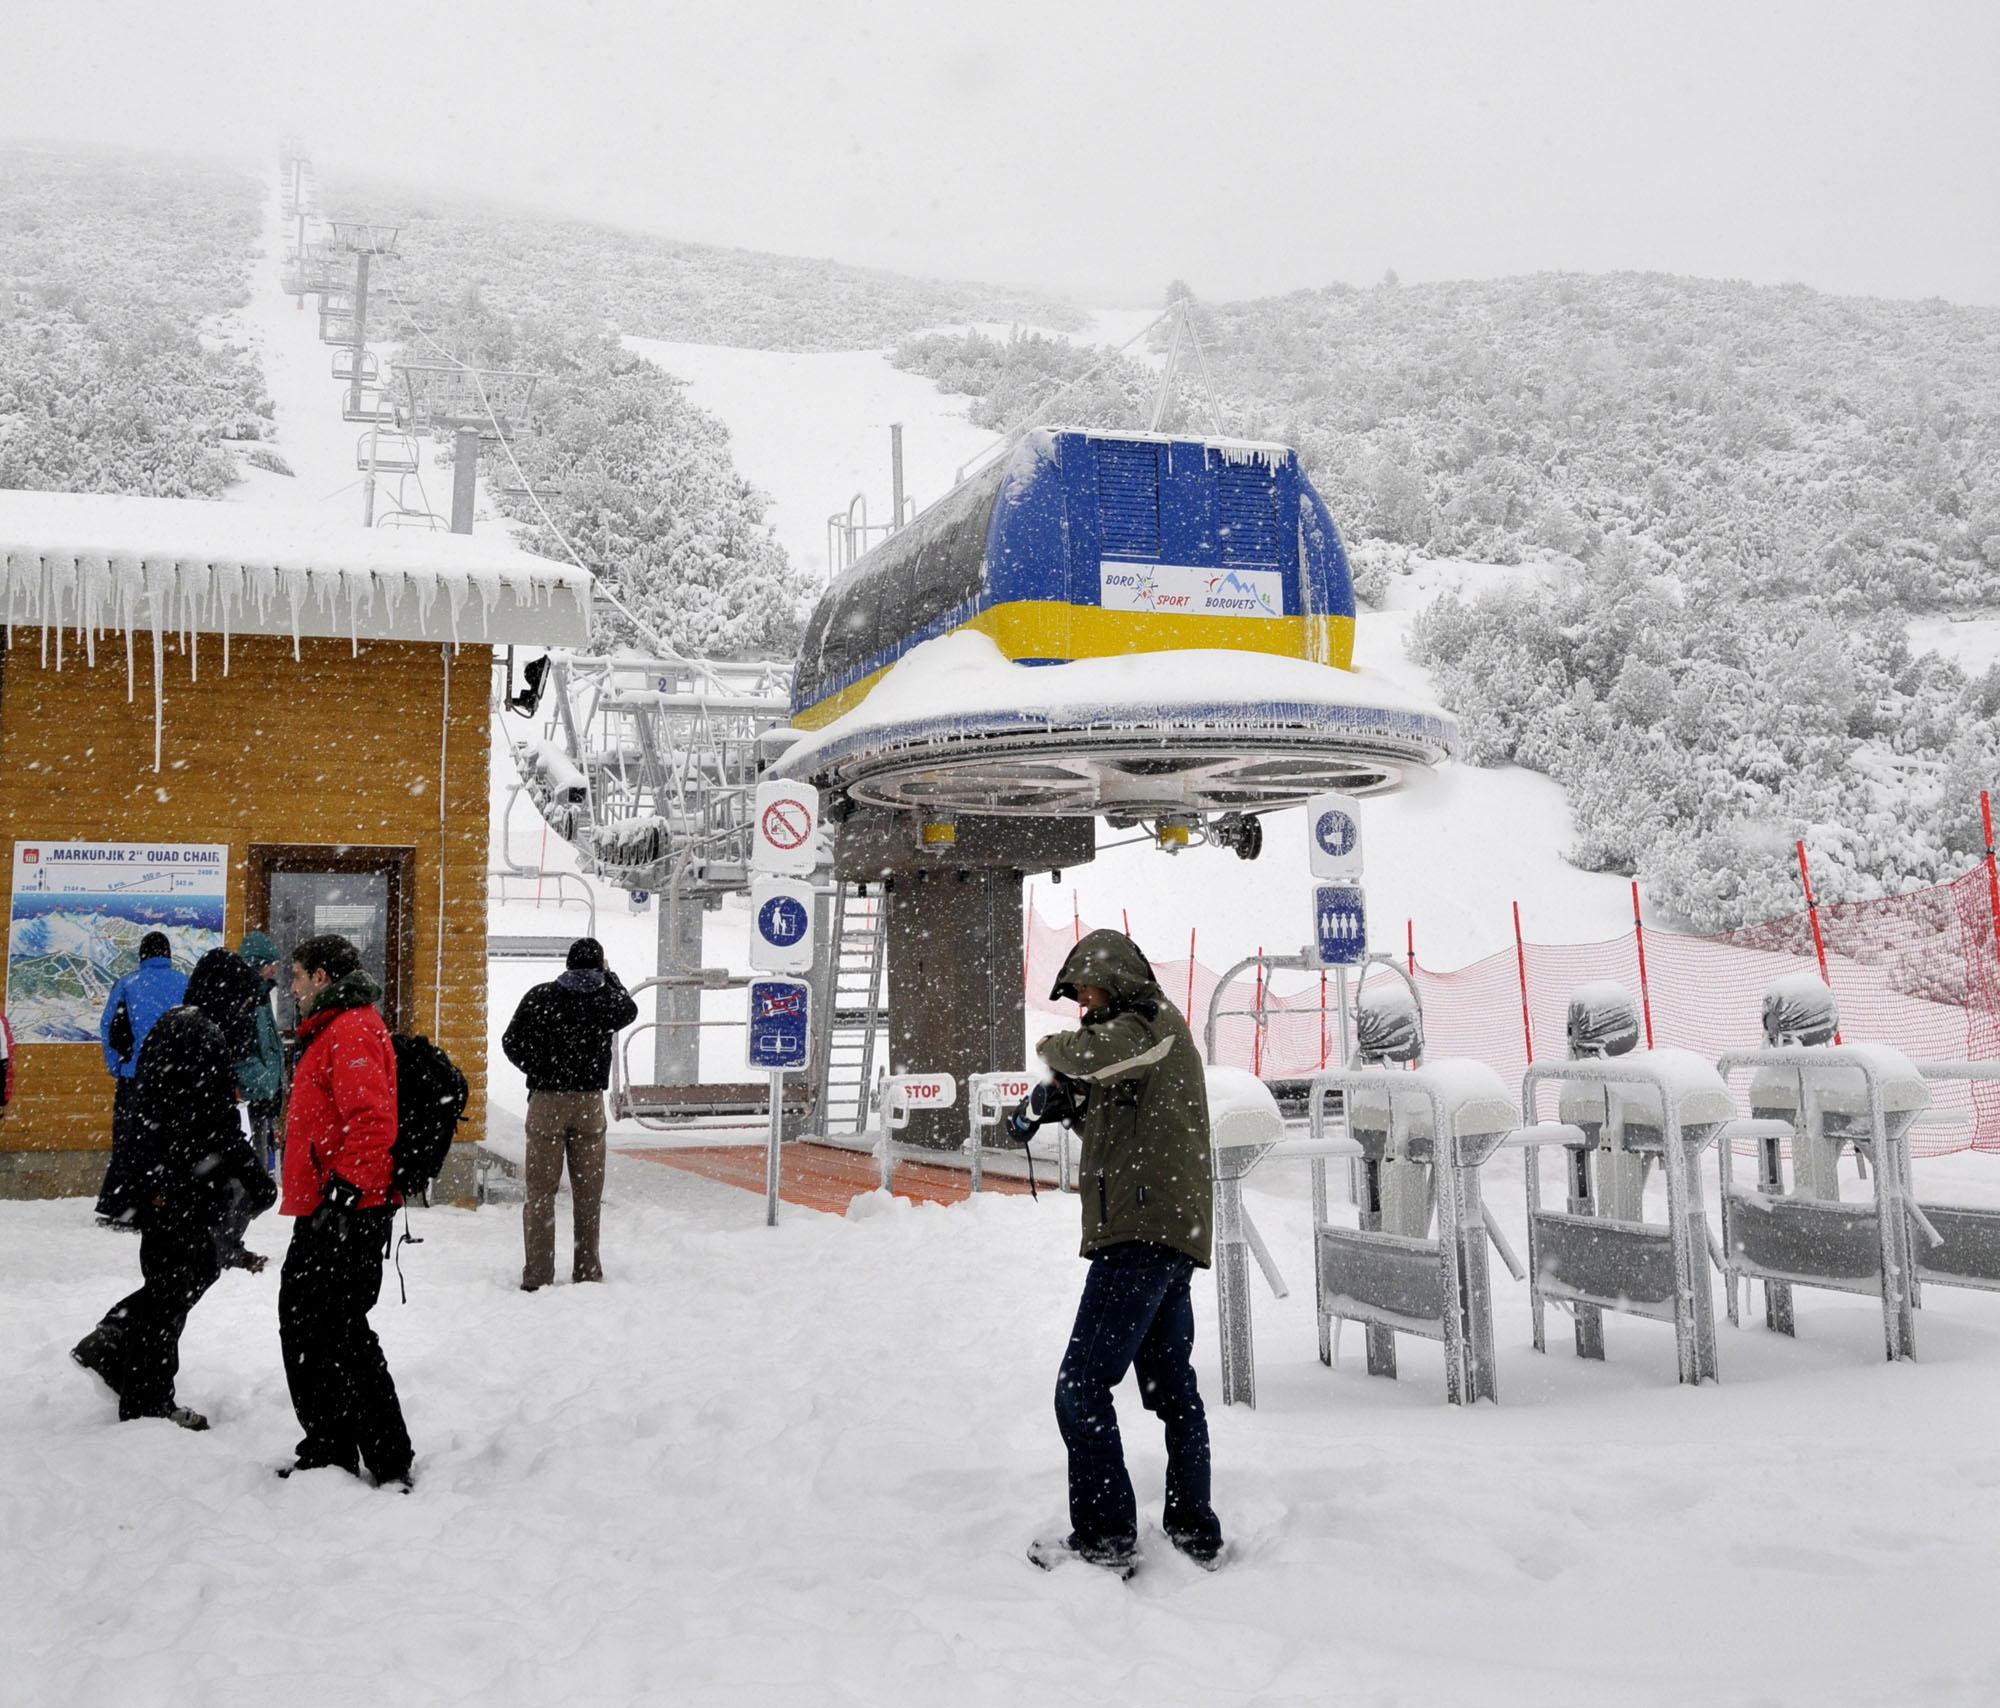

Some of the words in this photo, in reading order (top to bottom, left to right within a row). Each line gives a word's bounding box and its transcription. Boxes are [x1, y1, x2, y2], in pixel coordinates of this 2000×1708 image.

[1105, 574, 1135, 587] BORO
[1156, 594, 1190, 607] SPORT
[1205, 597, 1256, 610] BOROVETS
[658, 677, 667, 692] 2
[147, 850, 179, 862] QUAD
[183, 851, 220, 862] CHAIR
[904, 1084, 941, 1099] STOP
